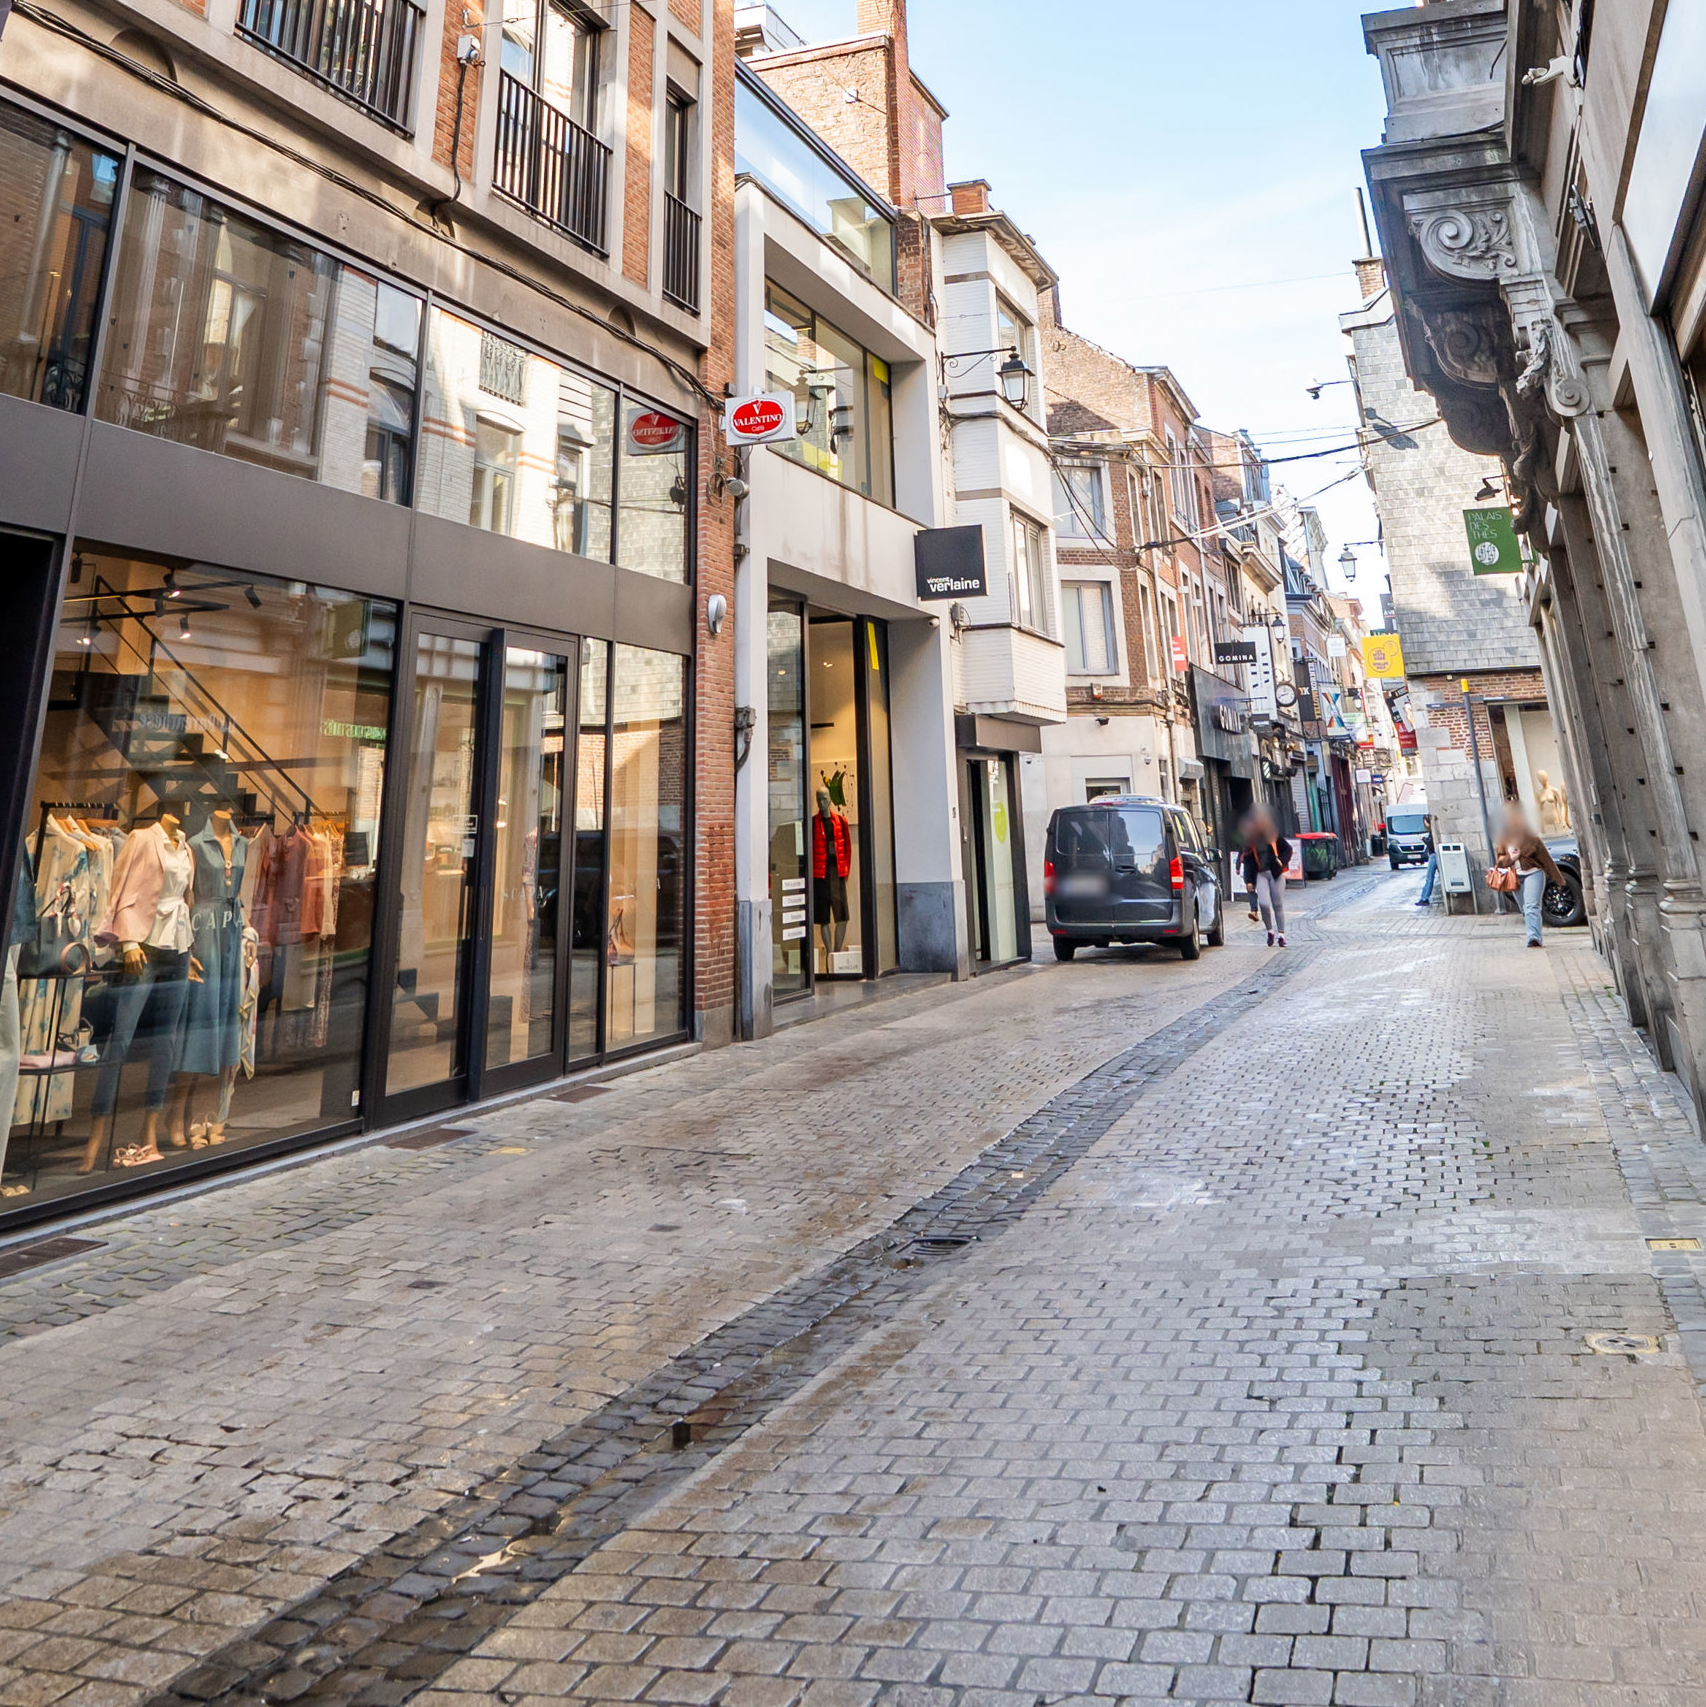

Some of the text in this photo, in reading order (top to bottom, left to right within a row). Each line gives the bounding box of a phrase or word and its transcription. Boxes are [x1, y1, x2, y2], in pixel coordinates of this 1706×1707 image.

[733, 413, 783, 427] VALENTINO
[1468, 510, 1503, 522] PALAIS
[929, 577, 980, 593] verlaine
[1218, 654, 1254, 662] GOMINA
